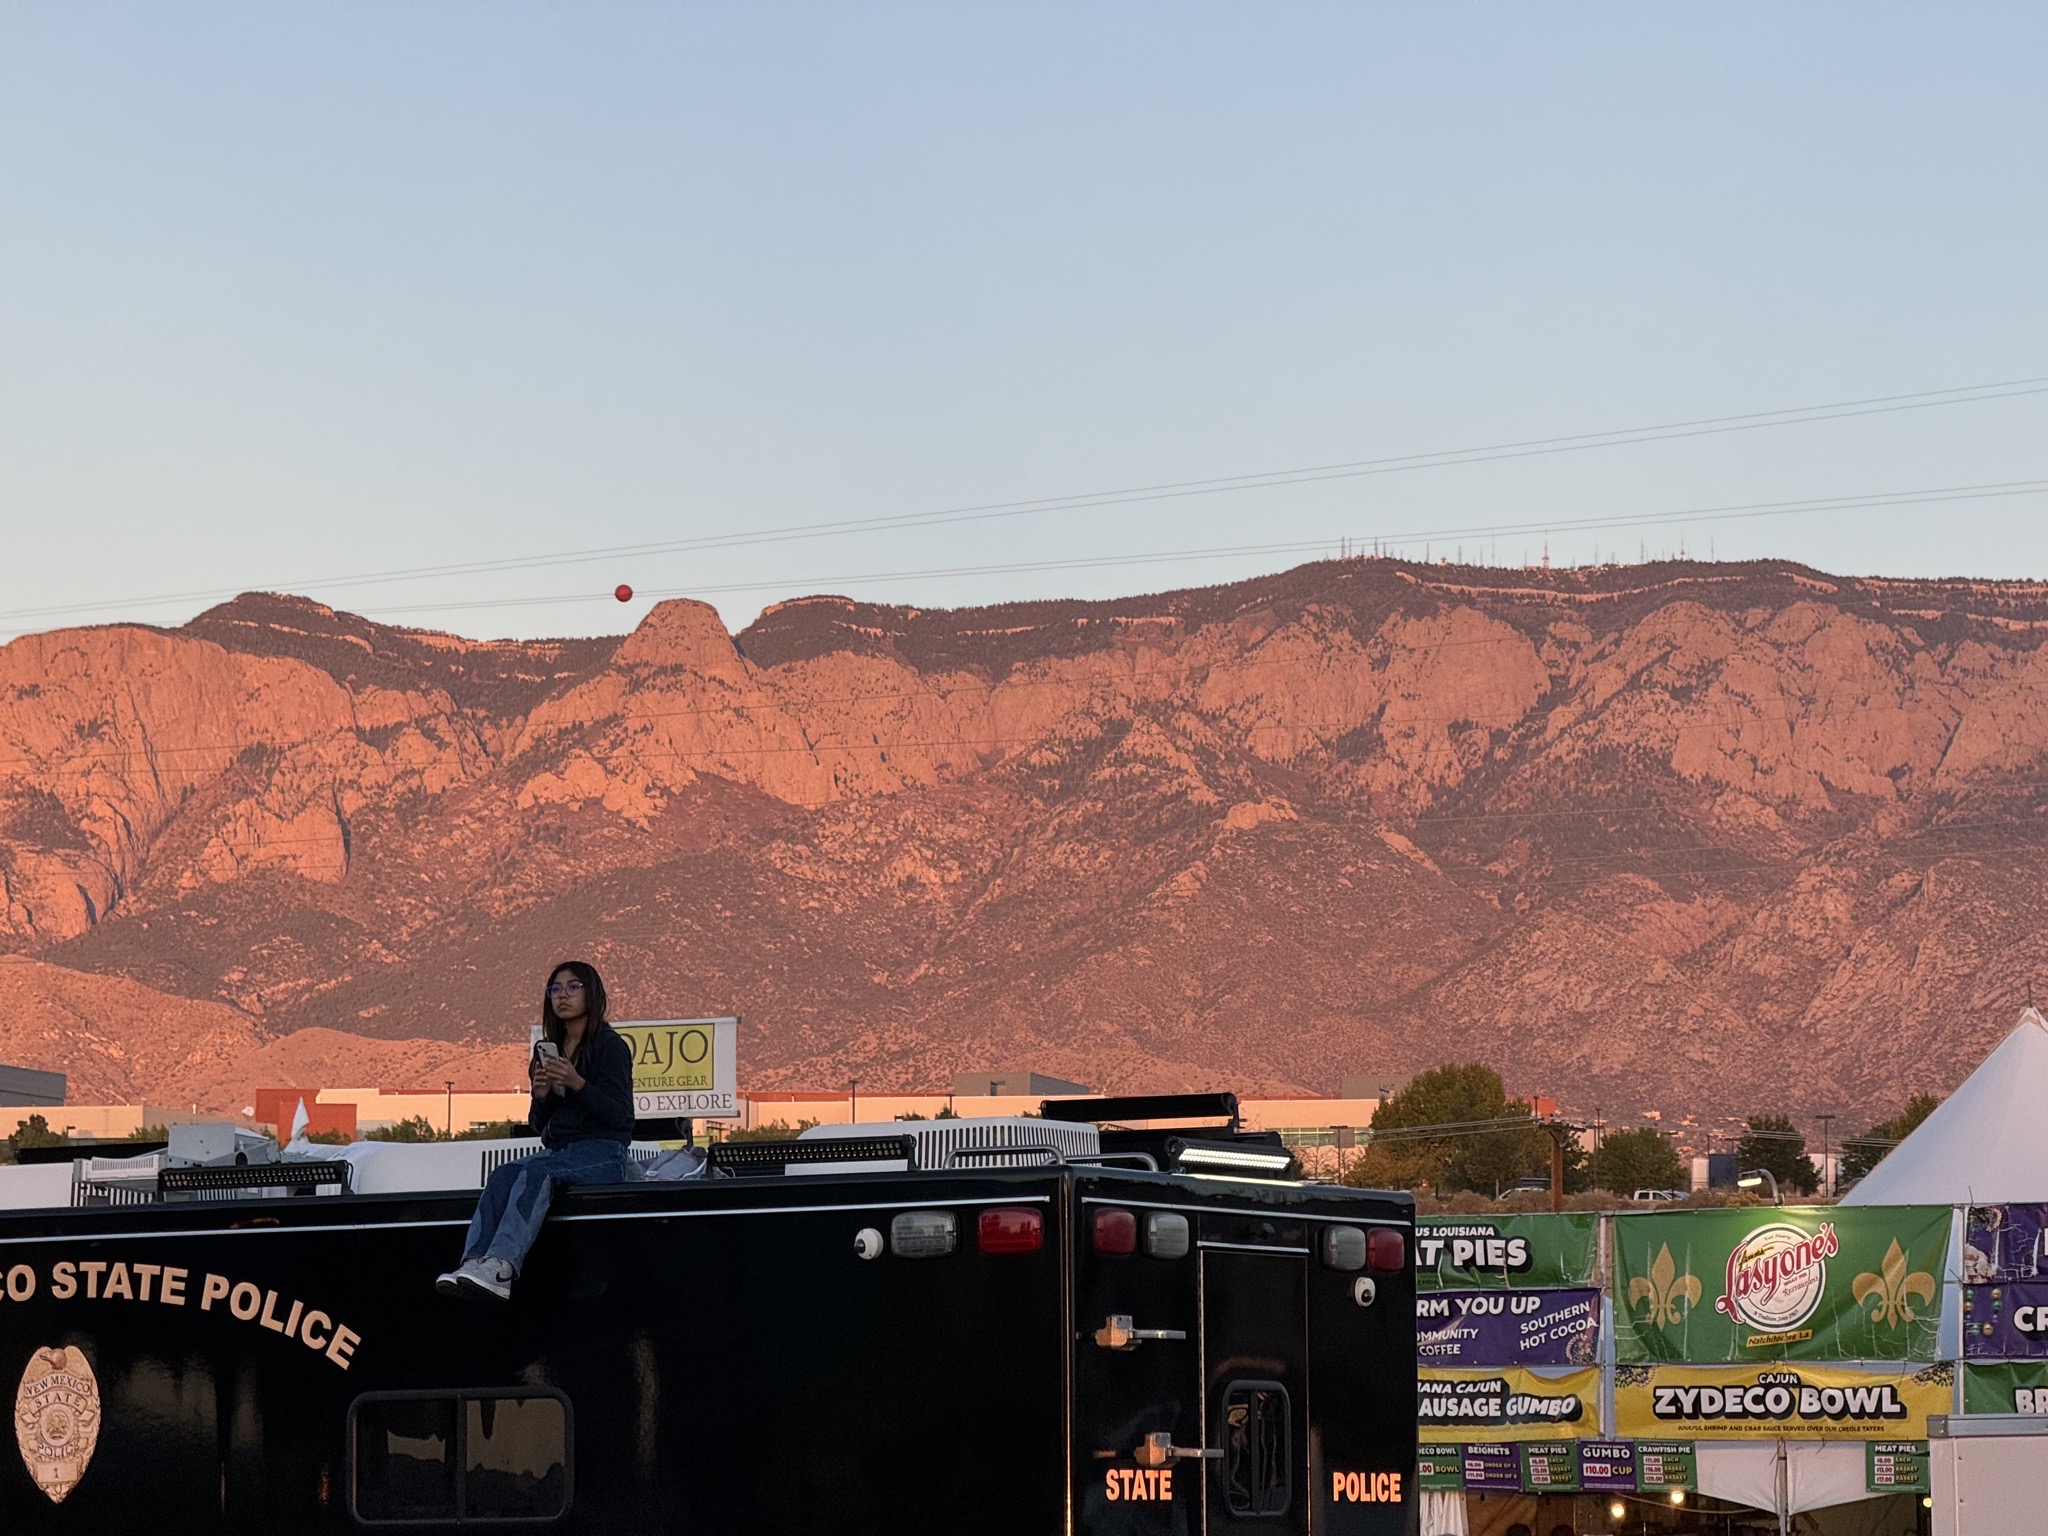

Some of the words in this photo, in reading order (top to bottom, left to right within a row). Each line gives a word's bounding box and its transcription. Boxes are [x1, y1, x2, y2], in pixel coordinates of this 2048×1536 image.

[676, 1075, 708, 1087] GEAR
[656, 1093, 733, 1111] EXPLORE
[1432, 1226, 1495, 1237] LOUISIANA
[1453, 1240, 1526, 1266] PIES
[1716, 1222, 1838, 1323] Lasyone's
[1782, 1276, 1819, 1296] Restaurant
[1454, 1297, 1504, 1315] YOU
[1510, 1296, 1541, 1314] UP
[0, 1264, 36, 1302] O
[51, 1261, 189, 1306] STATE
[200, 1273, 362, 1371] POLICE
[1520, 1301, 1590, 1334] SOUTHERN
[1520, 1332, 1547, 1351] HOT
[1550, 1317, 1599, 1340] COCOA
[1419, 1344, 1461, 1356] COFFEE
[26, 1378, 49, 1395] NEW
[50, 1375, 91, 1393] MEXICO
[1456, 1381, 1501, 1394] CAJUN
[1759, 1373, 1798, 1385] CAJUN
[36, 1392, 81, 1408] STATE
[1418, 1398, 1501, 1417] AUSAGE
[1506, 1396, 1576, 1416] GUMBO
[1655, 1388, 1790, 1414] ZYDECO
[1799, 1388, 1901, 1413] BOWL
[38, 1443, 79, 1458] POLICE
[1436, 1447, 1456, 1455] BOWL
[1468, 1446, 1510, 1455] BEIGNETS
[1583, 1447, 1630, 1459] GUMBO
[53, 1468, 60, 1480] 1
[1585, 1465, 1609, 1475] $10.00
[1612, 1466, 1633, 1475] CUP
[1106, 1469, 1172, 1500] STATE
[1333, 1472, 1401, 1502] POLICE
